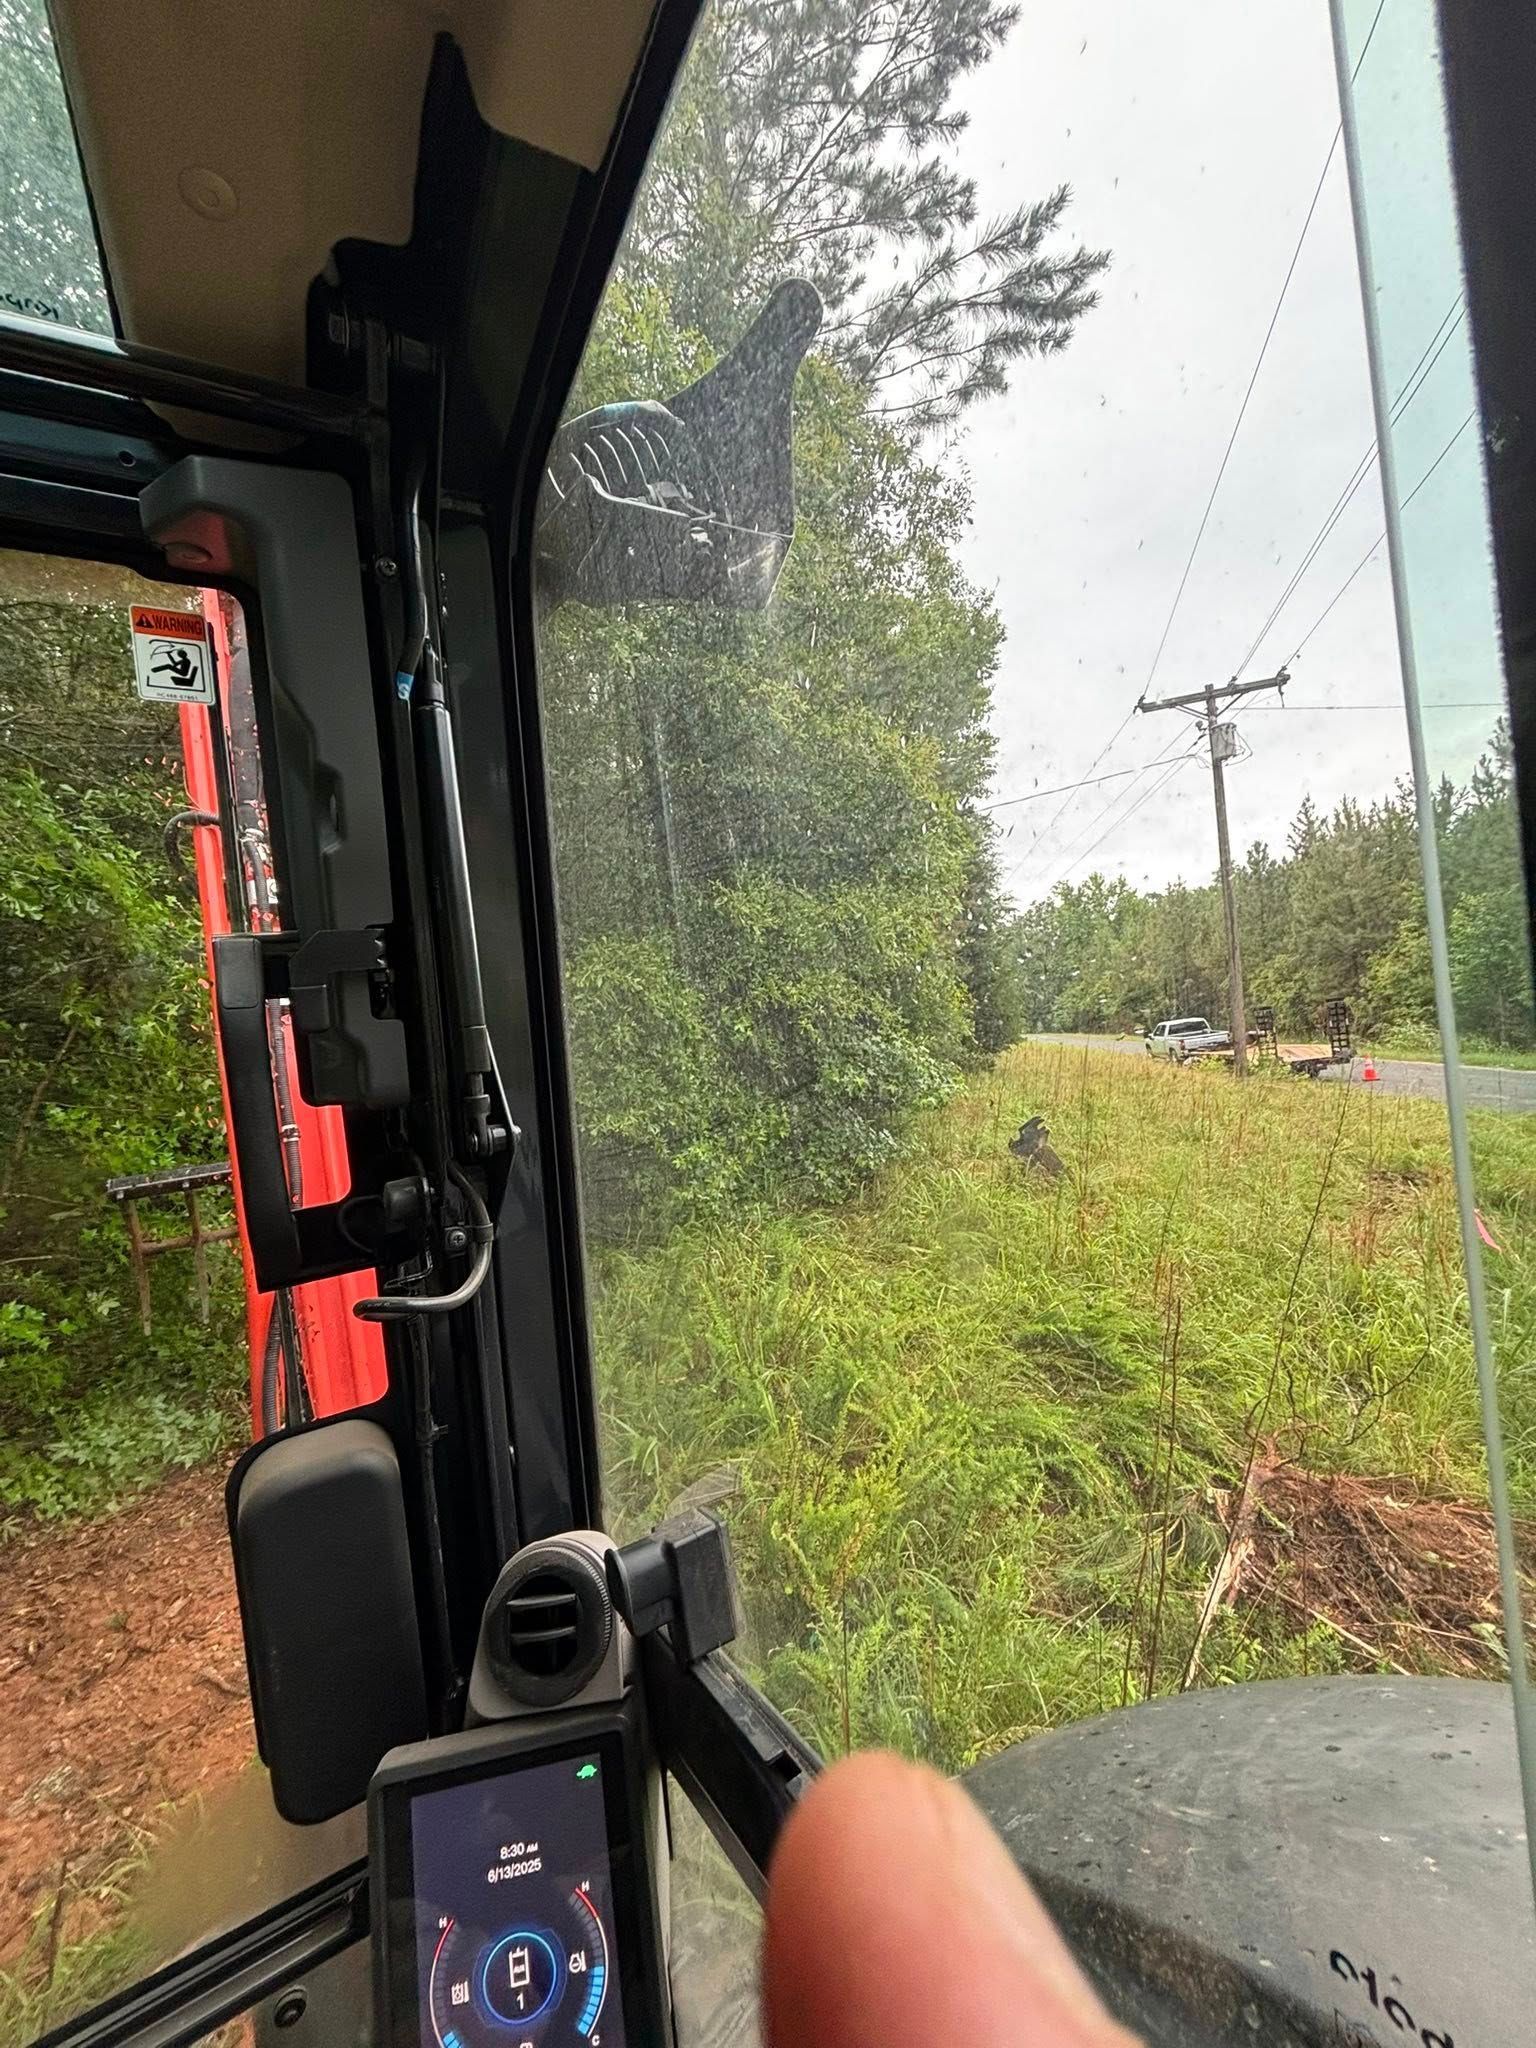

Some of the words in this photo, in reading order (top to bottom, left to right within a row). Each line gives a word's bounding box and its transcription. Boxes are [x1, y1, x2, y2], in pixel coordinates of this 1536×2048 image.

[152, 614, 203, 635] WARNING
[500, 1842, 525, 1860] 8:30
[526, 1842, 539, 1853] AM
[487, 1857, 542, 1884] 6/13/2025
[581, 1881, 590, 1893] H
[438, 1917, 447, 1929] H
[516, 1992, 525, 2010] 1
[591, 2034, 600, 2046] C
